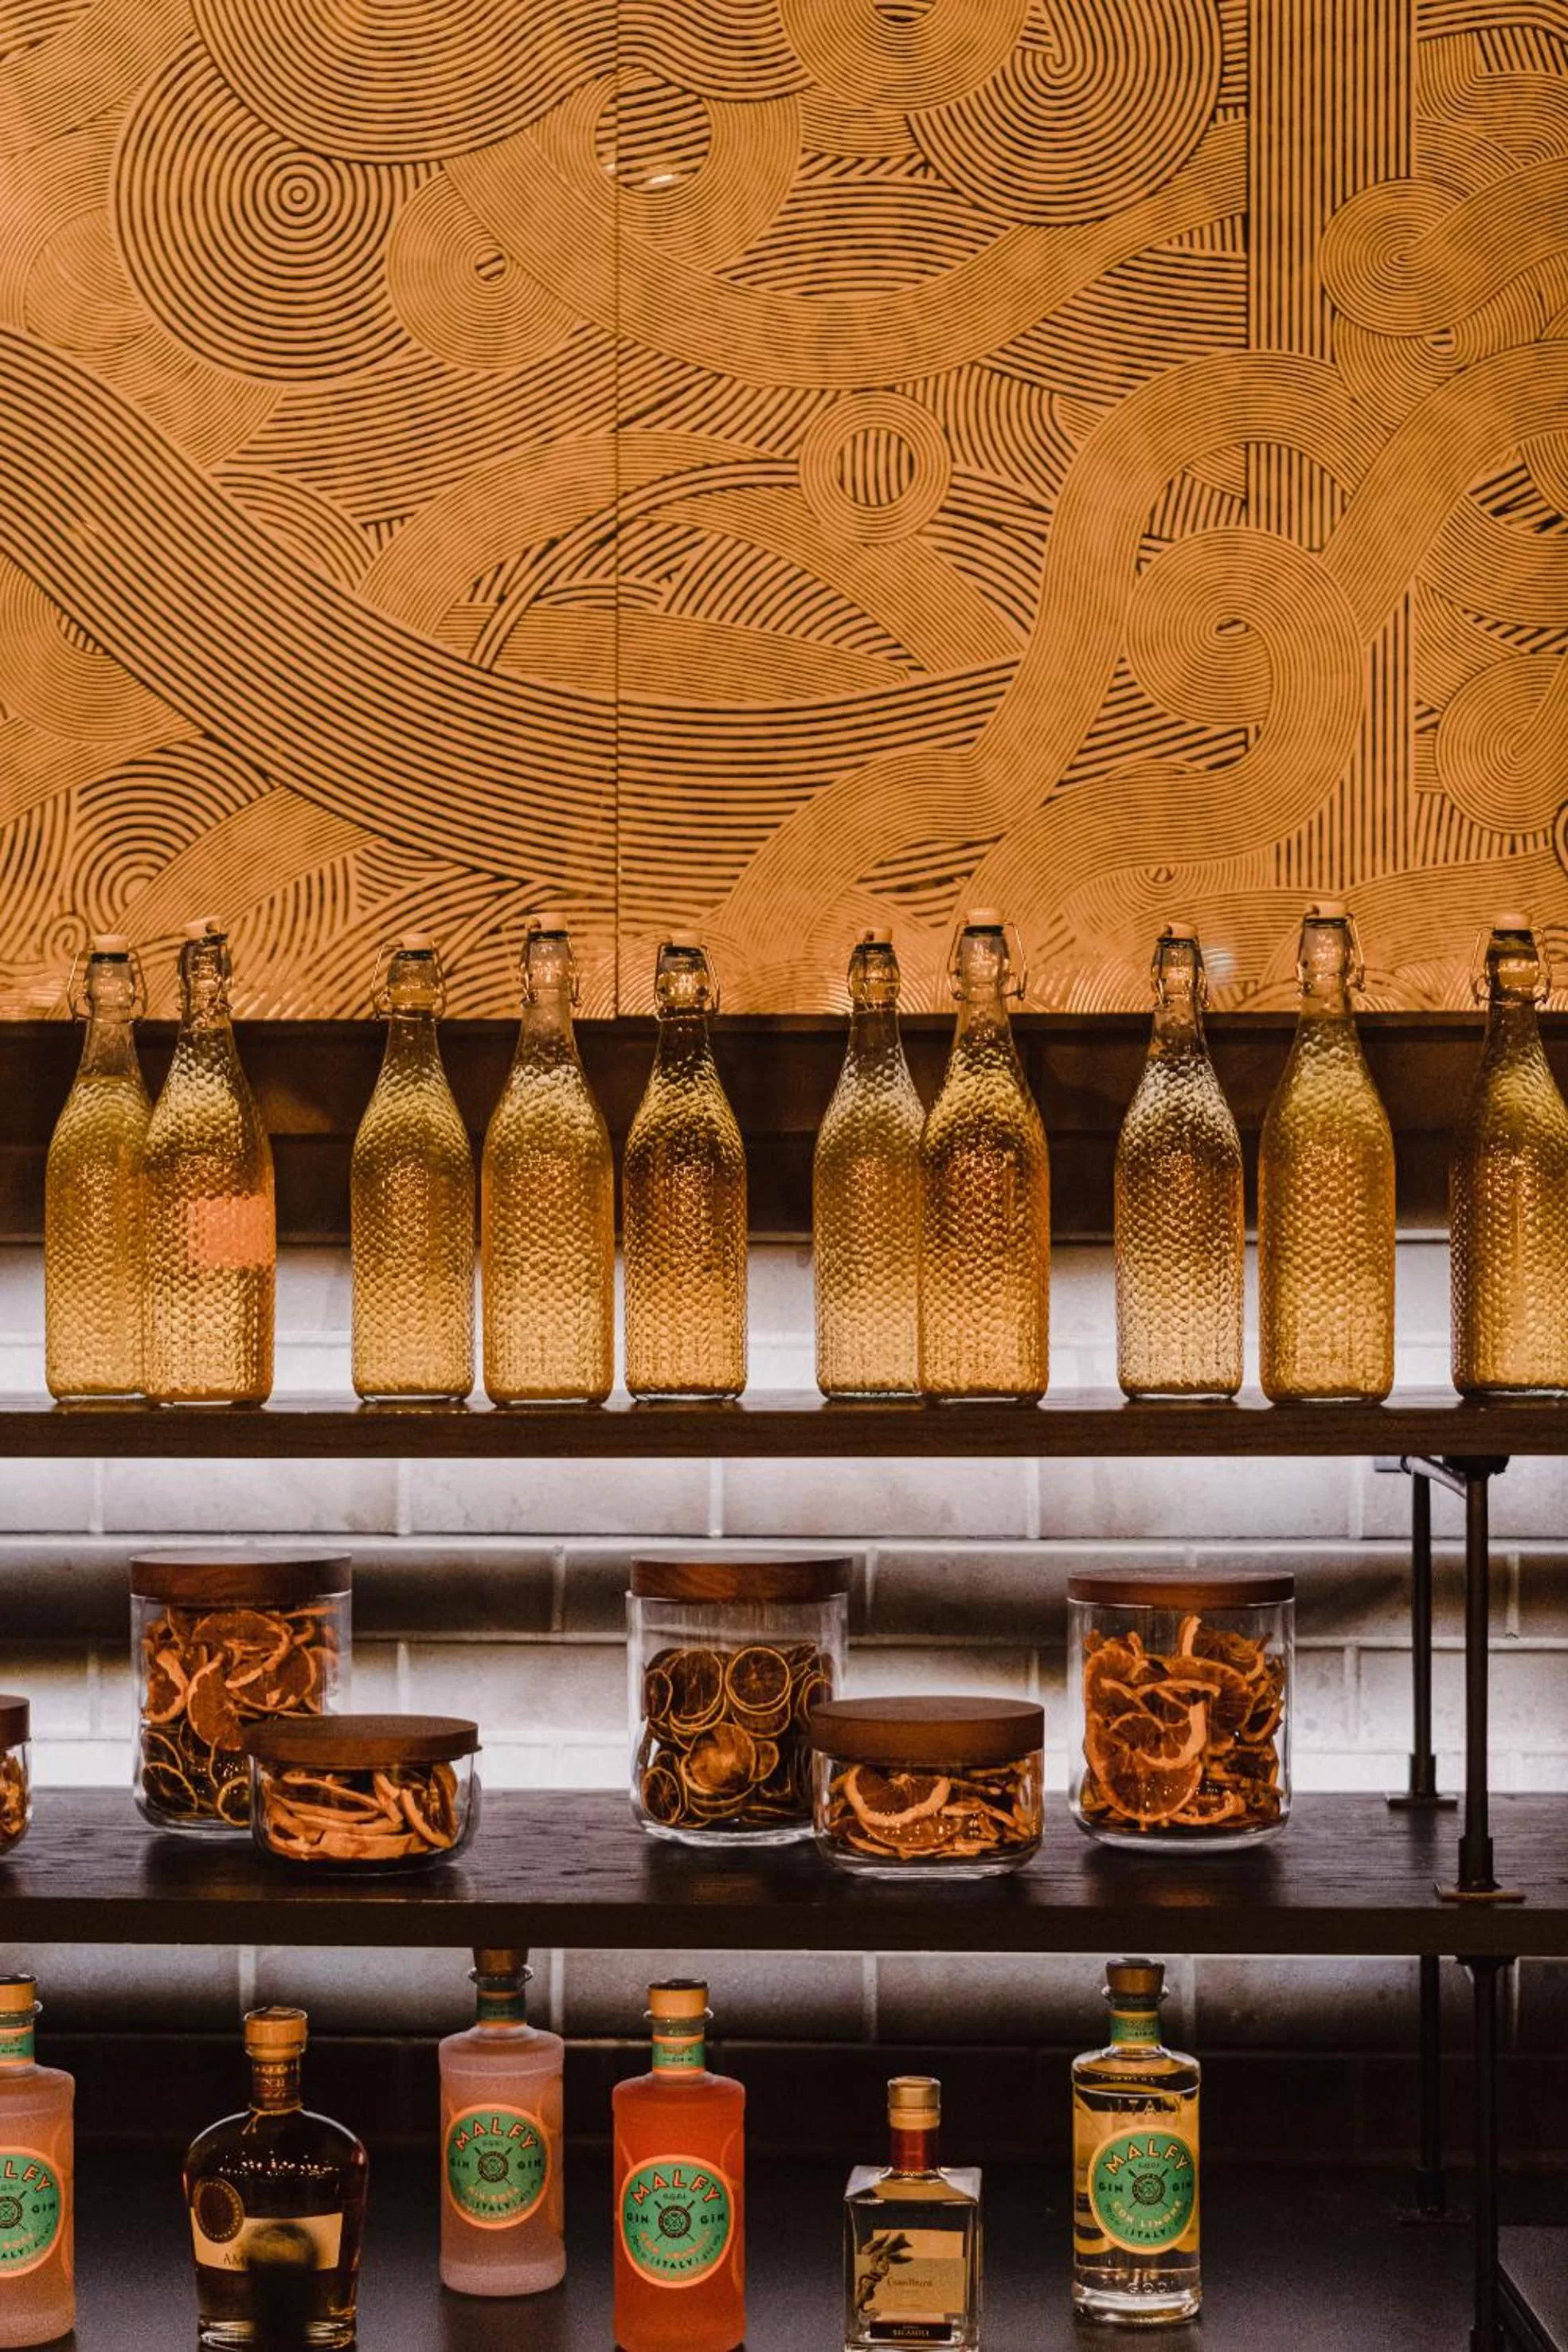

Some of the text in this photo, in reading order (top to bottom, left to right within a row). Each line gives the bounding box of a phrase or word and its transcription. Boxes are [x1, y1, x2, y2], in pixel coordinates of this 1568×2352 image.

[453, 2117, 538, 2152] MALFY
[1102, 2138, 1191, 2175] MALFY
[0, 2160, 53, 2192] LFY
[631, 2169, 721, 2205] MALFY
[1098, 2182, 1124, 2193] GIN
[32, 2201, 56, 2213] GIN
[626, 2213, 649, 2224] GIN
[700, 2212, 725, 2225] GIN
[655, 2258, 694, 2270] ITALY
